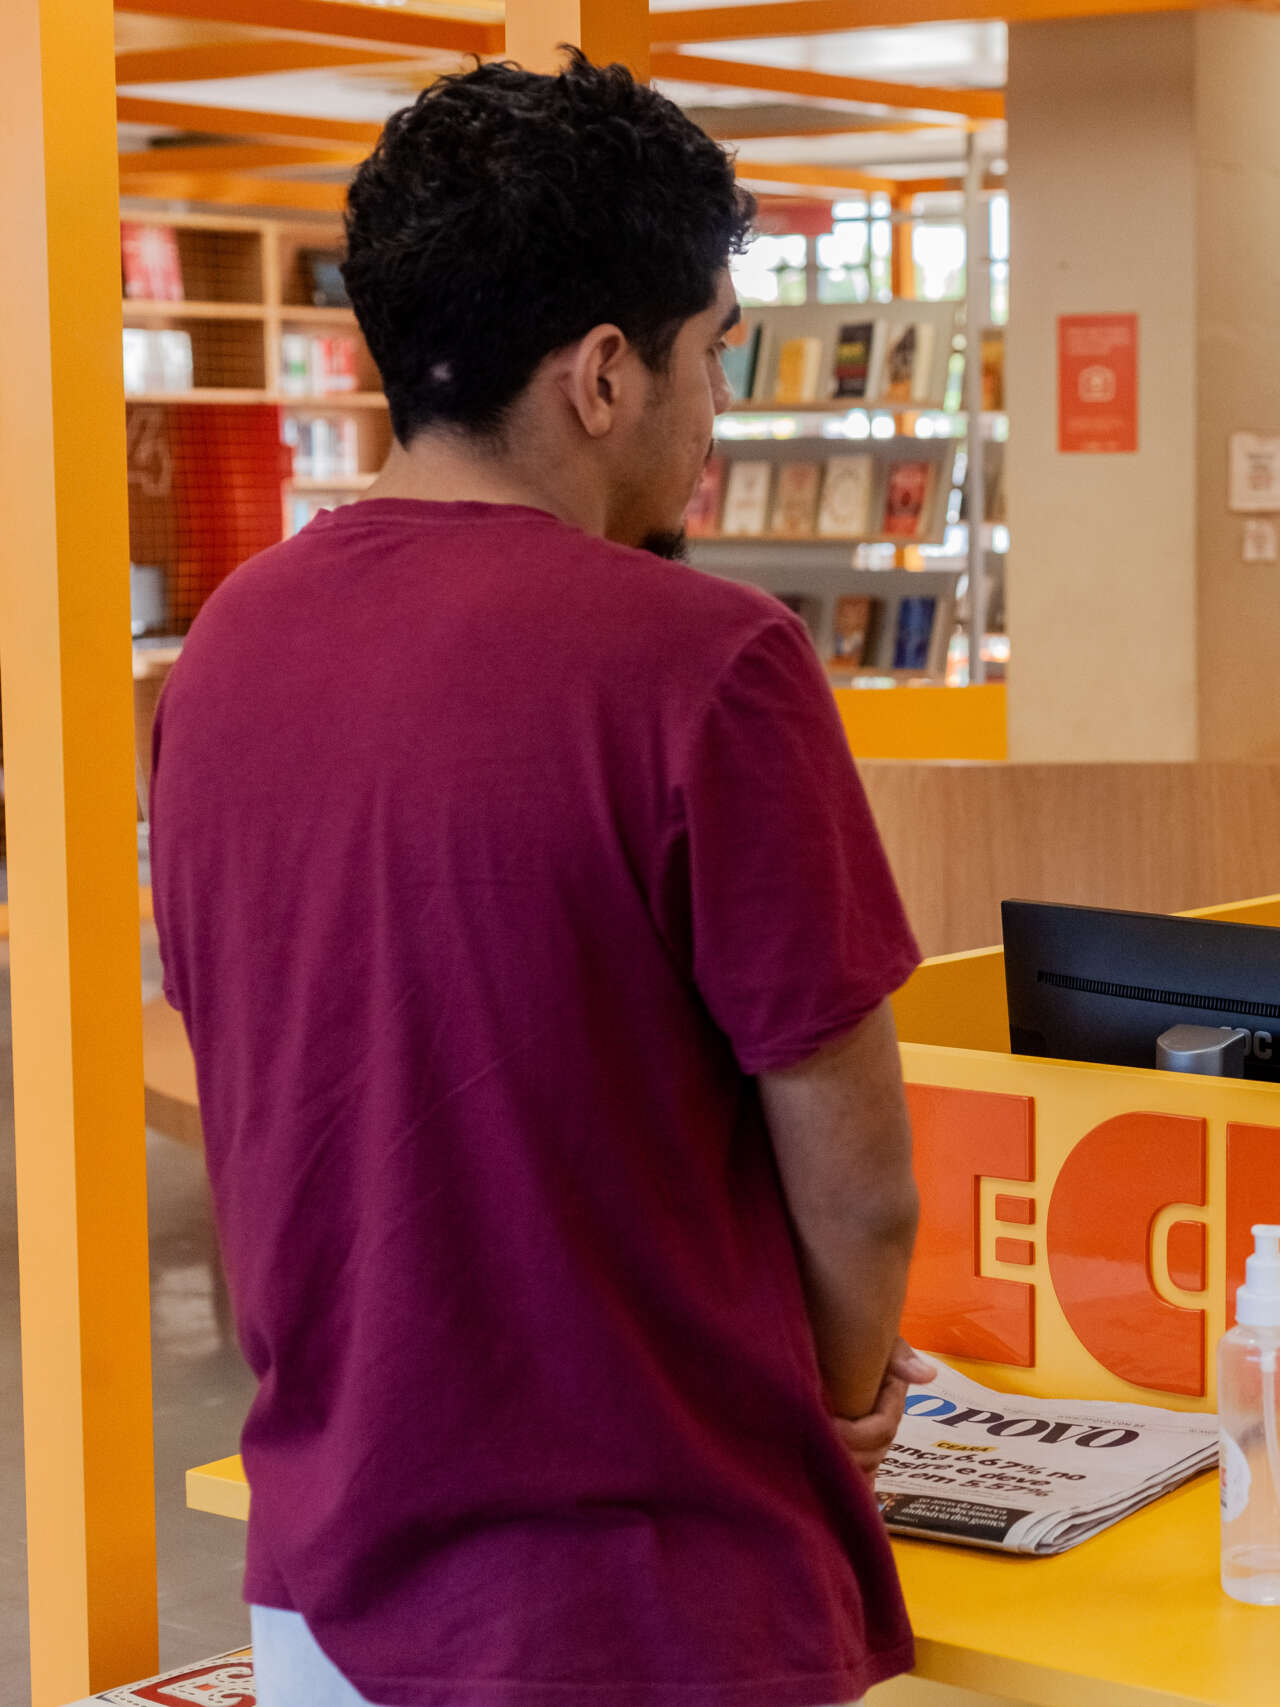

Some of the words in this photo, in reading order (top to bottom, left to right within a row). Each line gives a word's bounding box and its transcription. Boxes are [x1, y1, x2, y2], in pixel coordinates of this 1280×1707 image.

[904, 1394, 957, 1417] O
[932, 1407, 1141, 1448] POVO
[908, 1473, 957, 1484] em
[956, 1468, 977, 1476] e
[978, 1472, 1051, 1486] deve
[1046, 1472, 1087, 1481] no
